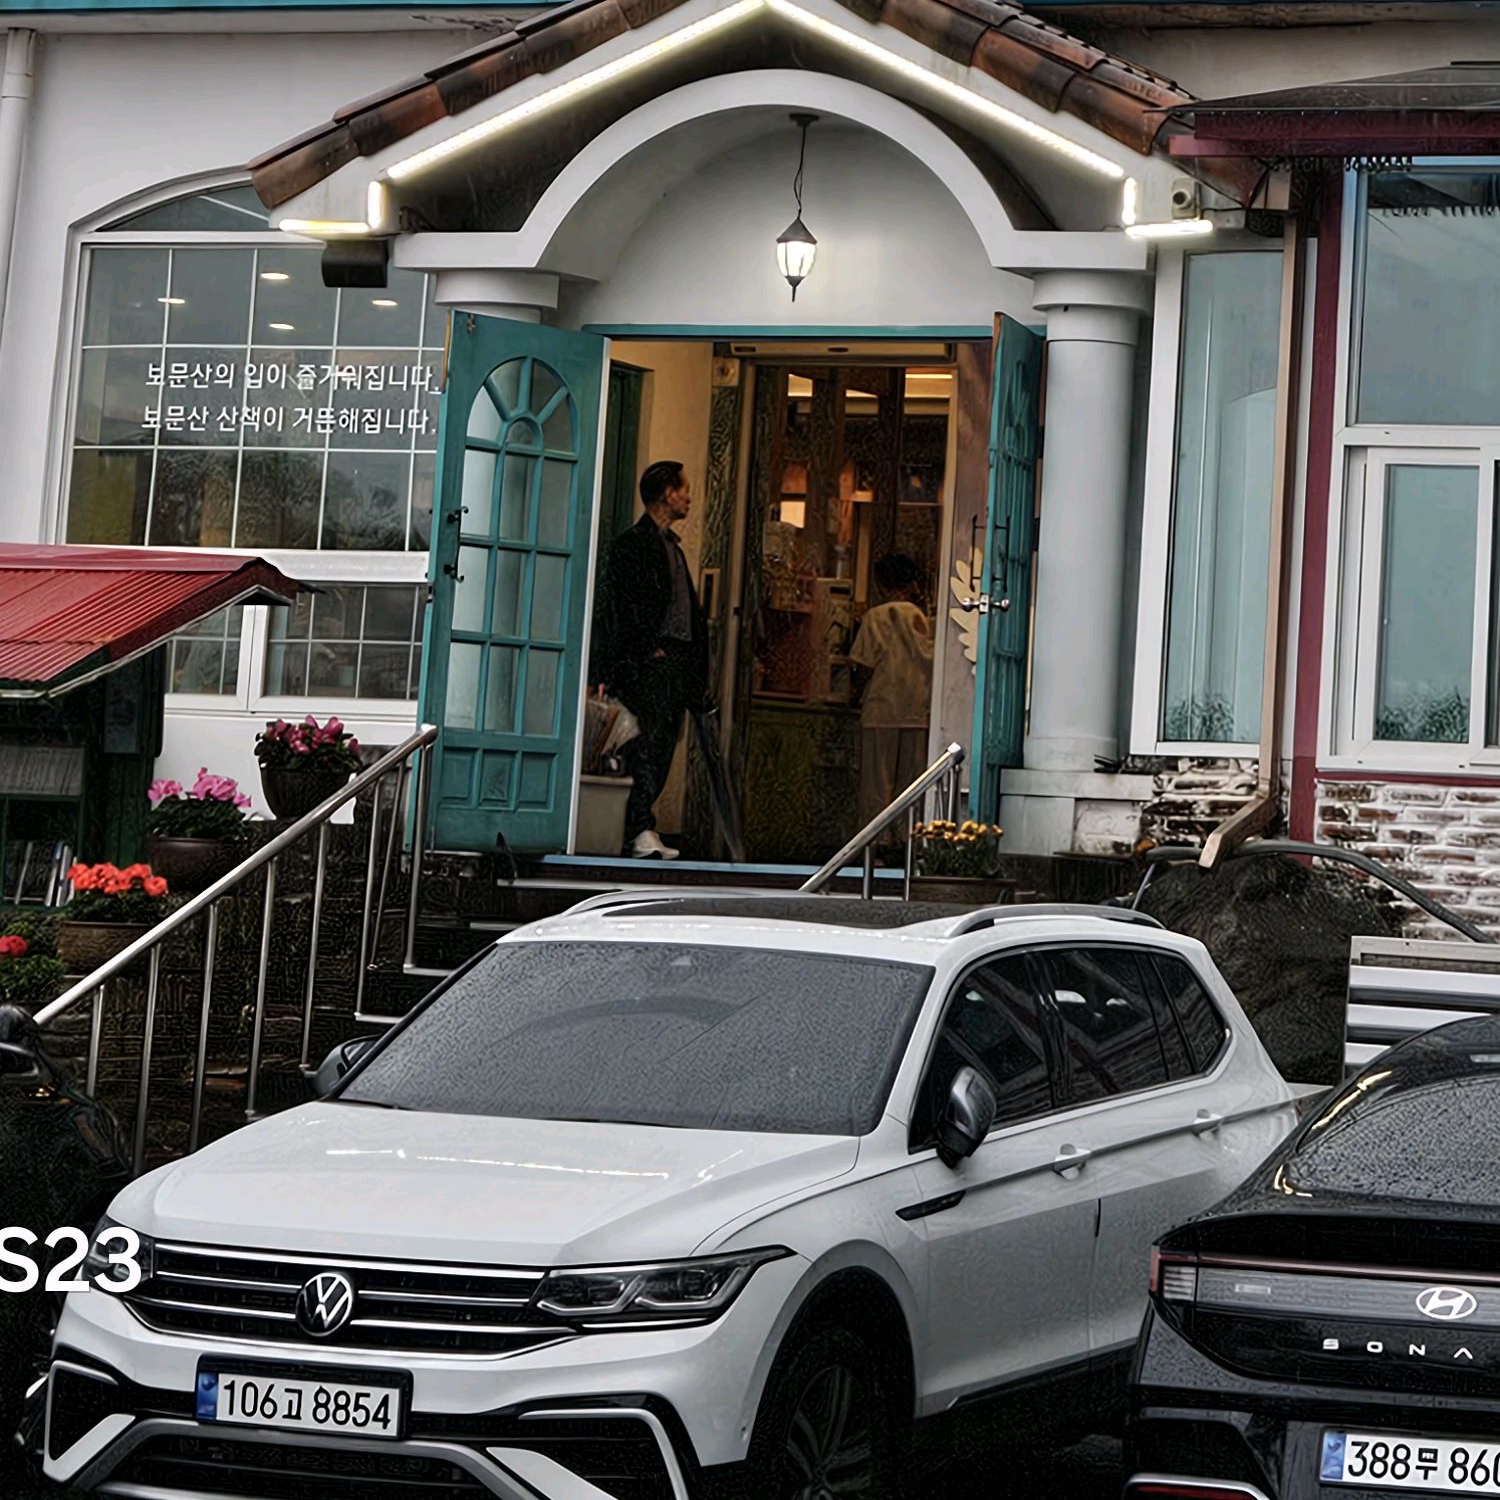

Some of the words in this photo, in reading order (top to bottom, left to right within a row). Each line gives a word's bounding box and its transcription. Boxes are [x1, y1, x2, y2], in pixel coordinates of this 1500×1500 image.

[145, 363, 235, 388] 보문산의
[245, 363, 287, 389] 입이
[141, 405, 209, 431] 보문산
[216, 406, 284, 432] 산책이
[223, 1380, 303, 1421] 106고
[312, 1385, 392, 1430] 8854
[1347, 1440, 1439, 1481] 388무
